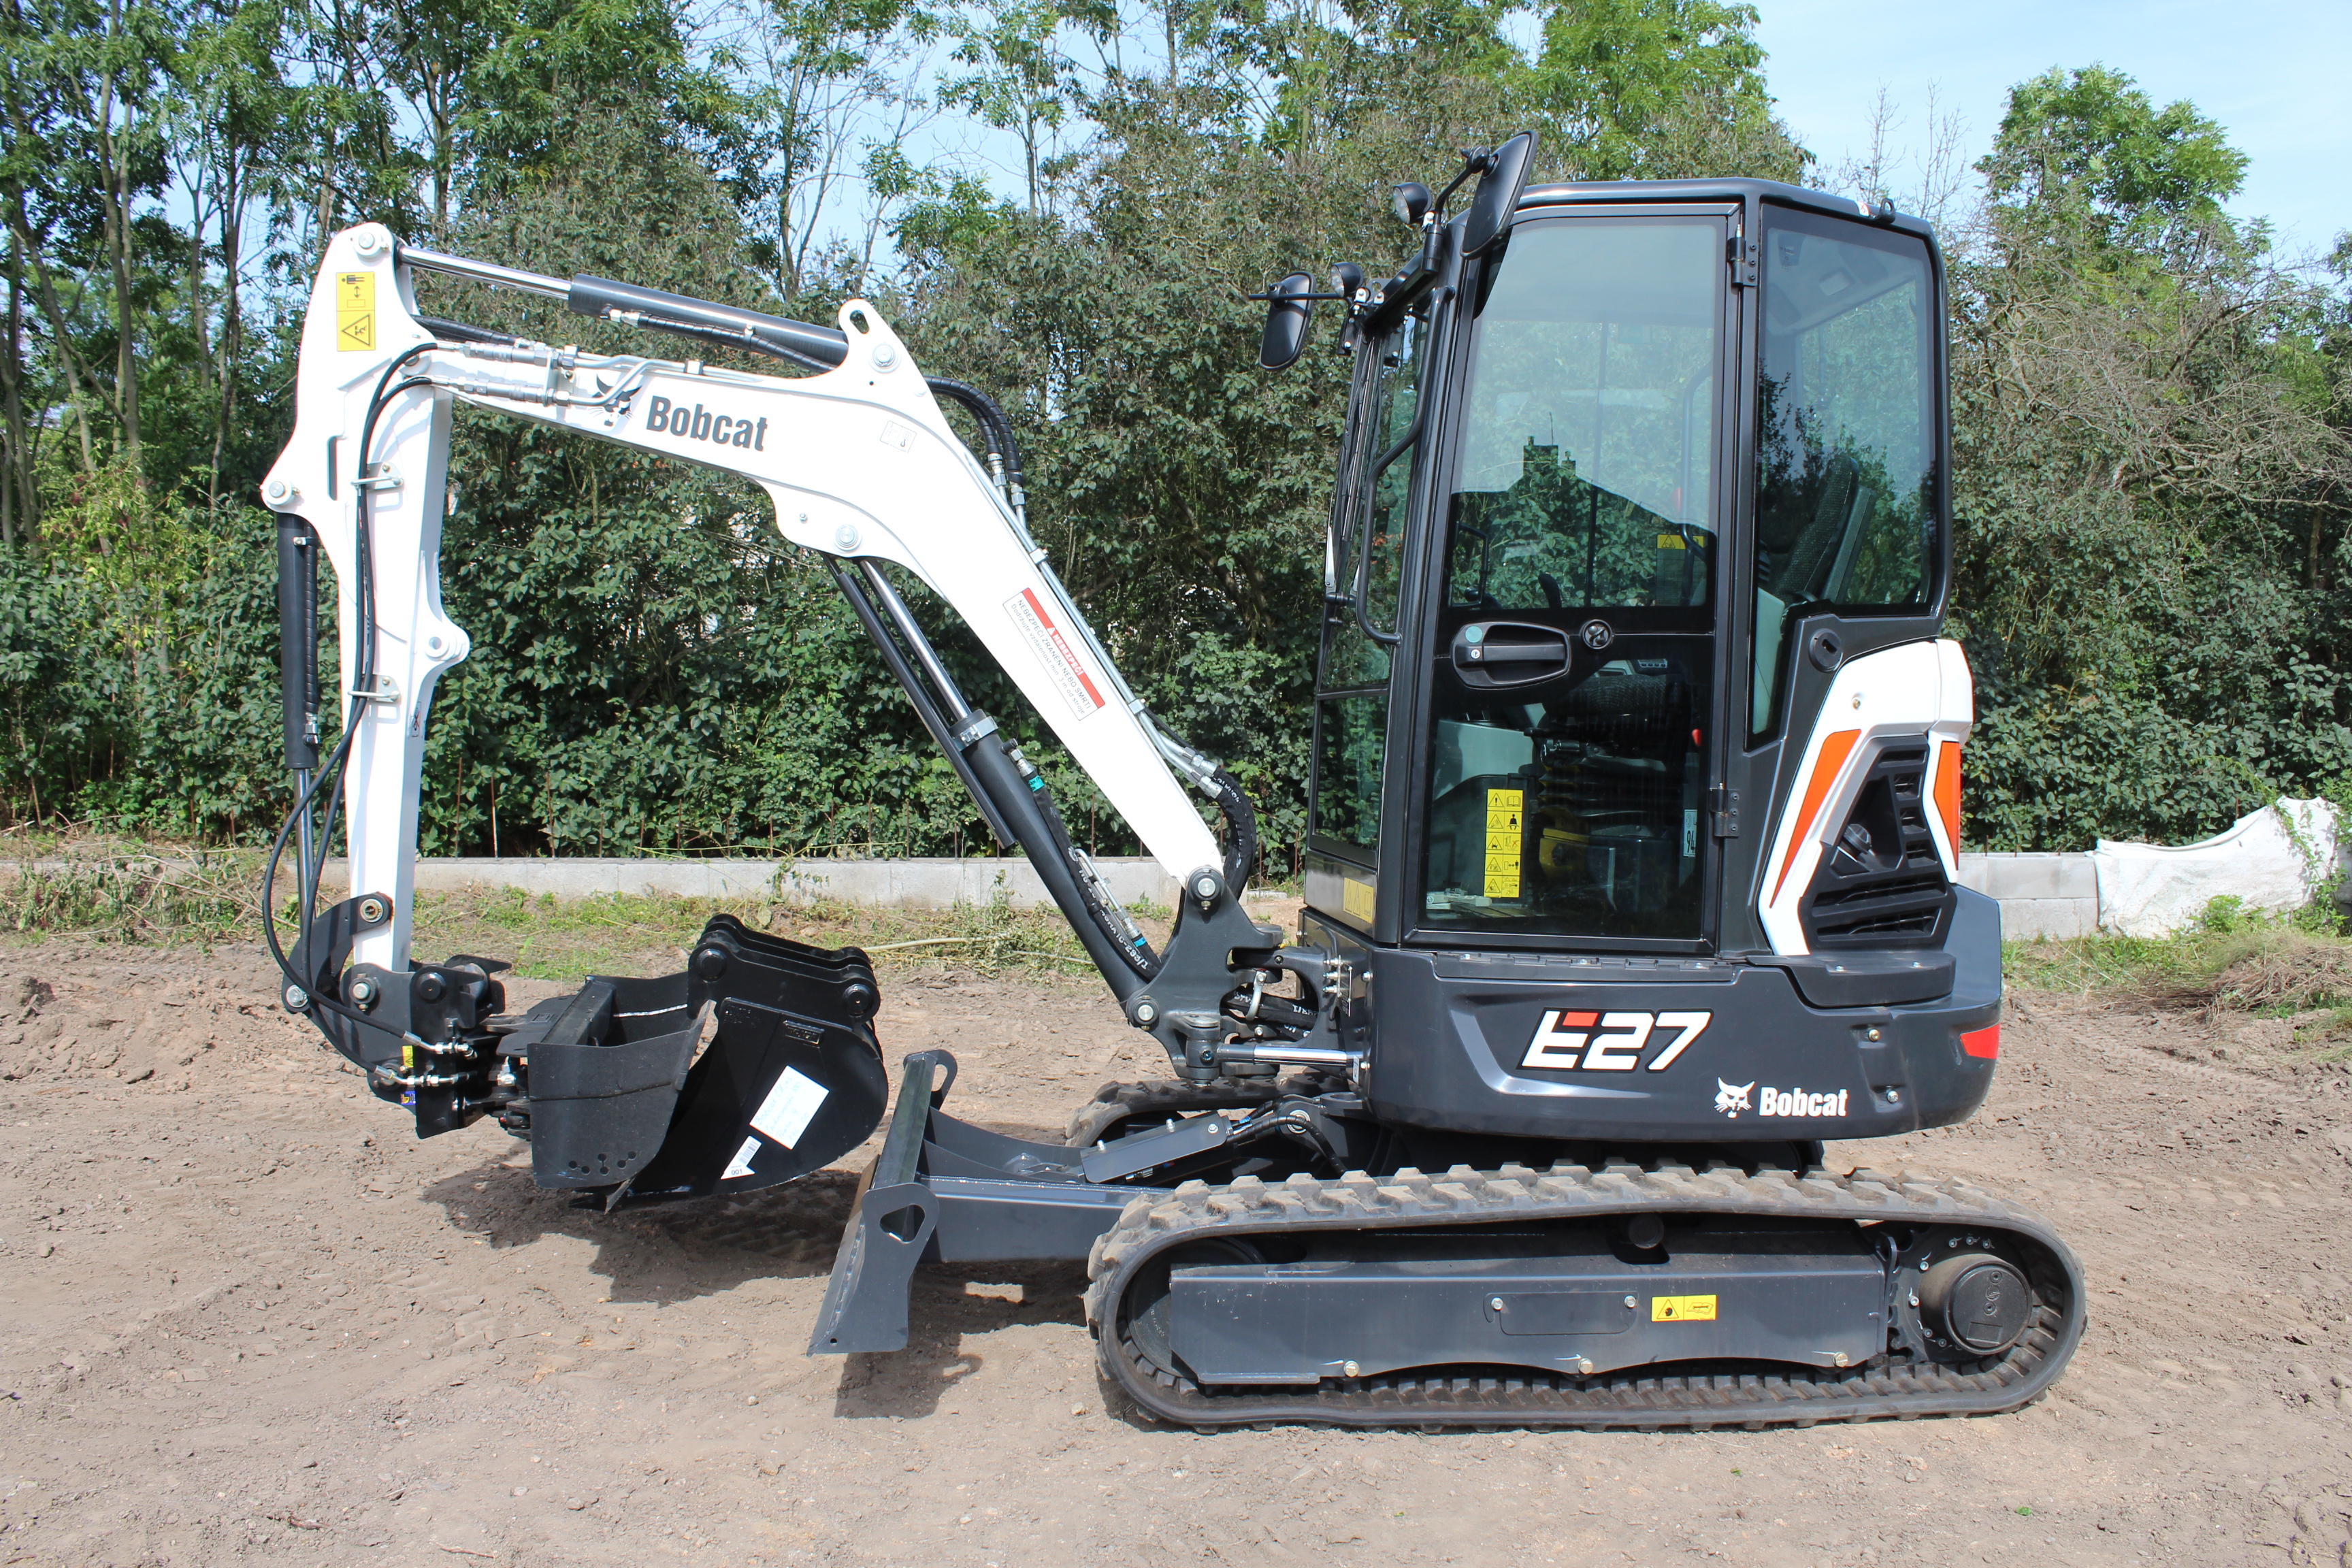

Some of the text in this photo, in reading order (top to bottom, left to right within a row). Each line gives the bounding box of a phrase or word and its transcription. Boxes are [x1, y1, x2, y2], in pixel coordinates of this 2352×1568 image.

[647, 395, 768, 452] Bobcat
[1062, 668, 1077, 687] NEBO
[1075, 687, 1091, 709] SMRTI
[1066, 689, 1075, 697] od
[1071, 697, 1085, 715] stroje
[1522, 1011, 1711, 1071] E27
[755, 1096, 777, 1125] Bobcat
[1759, 1086, 1848, 1117] Bobcat
